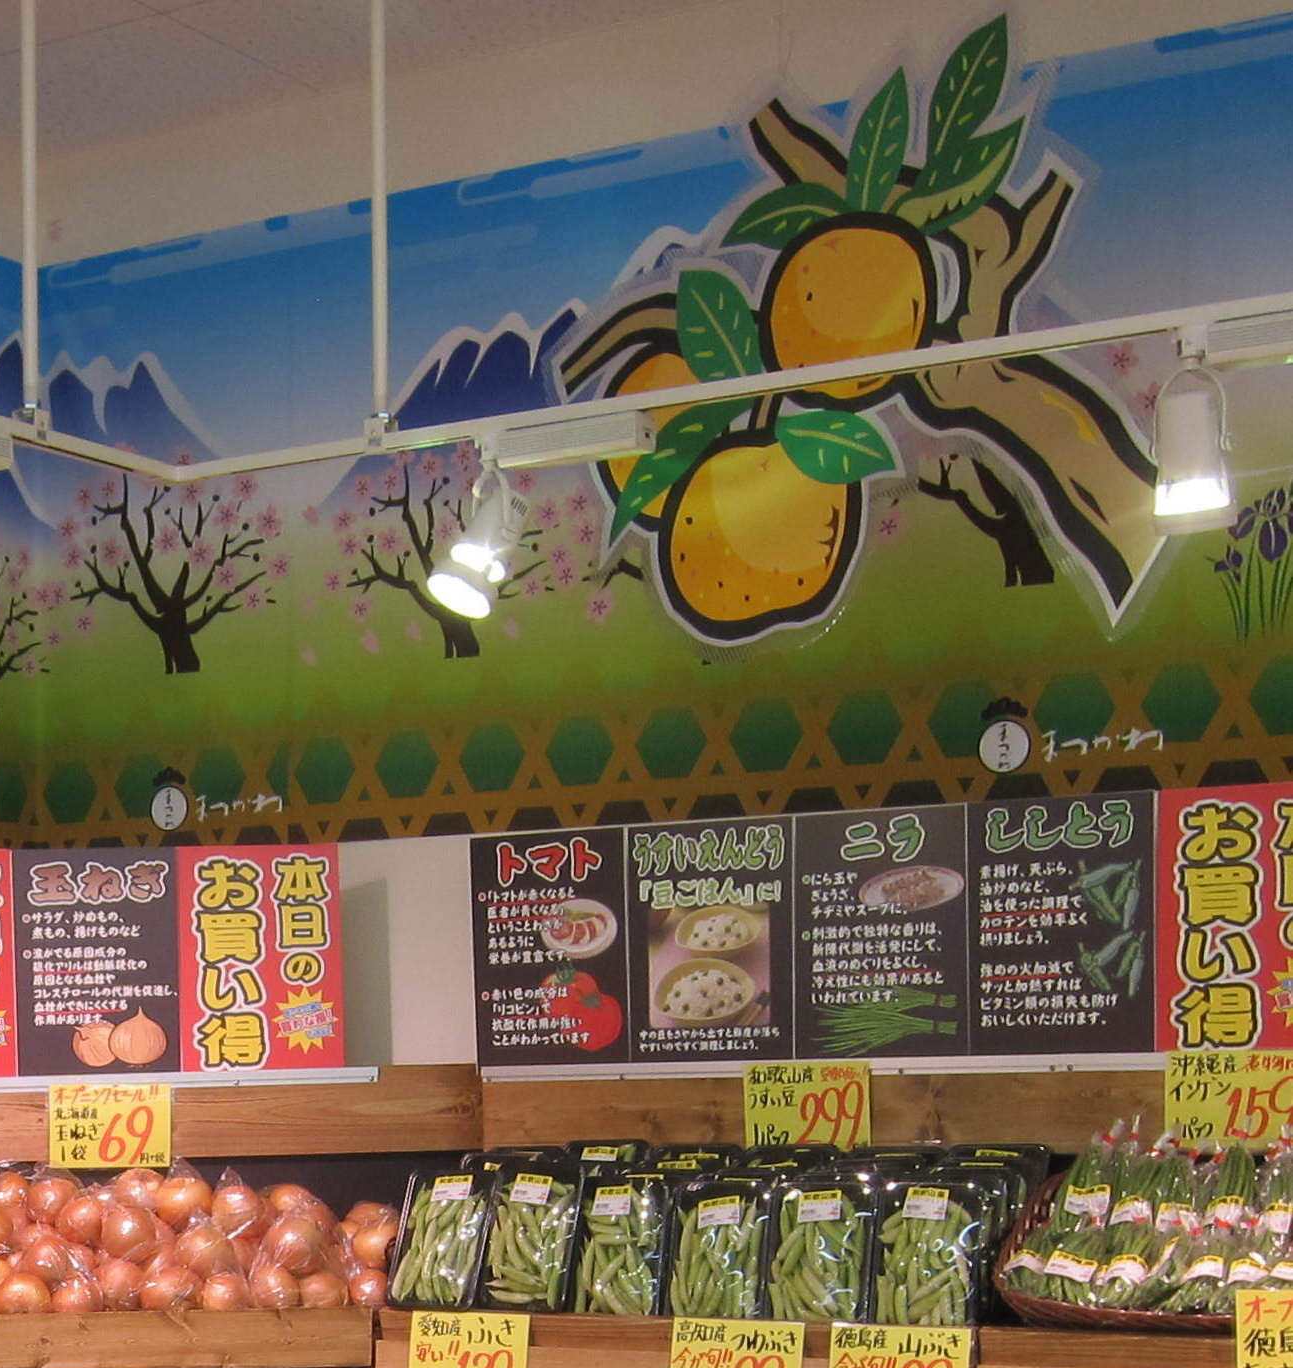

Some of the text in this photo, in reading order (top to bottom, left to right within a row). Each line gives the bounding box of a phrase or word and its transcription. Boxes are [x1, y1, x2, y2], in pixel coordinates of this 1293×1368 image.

[839, 812, 926, 863] ニラ
[986, 799, 1135, 853] ししとう
[497, 837, 603, 885] トマト
[633, 825, 784, 876] うすいえんどう
[26, 861, 168, 906] 玉ねぎ
[811, 872, 857, 885] にら玉や
[272, 853, 331, 985] 本日の
[980, 895, 1082, 912] 油を使った調理で
[31, 924, 141, 940] 煮もの、揚げものなど
[1169, 799, 1264, 1050] お買い得
[488, 936, 535, 949] あるように
[193, 856, 271, 1072] お買い得
[980, 961, 1074, 977] 強めの火加減で
[492, 987, 568, 1001] 赤い色の成分は
[980, 978, 1082, 993] サッと加熱すれば
[1171, 1054, 1236, 1077] 沖縄産
[1170, 1077, 1232, 1102] インゲン
[796, 1080, 865, 1150] 299
[56, 1123, 104, 1141] 玉ねぎ
[99, 1105, 154, 1165] 69
[61, 1144, 87, 1161] 1袋
[418, 1313, 516, 1347] 愛知産 ふき
[677, 1321, 797, 1355] 高知産 つわぶき
[834, 1327, 962, 1360] 徳島産 山ぶき
